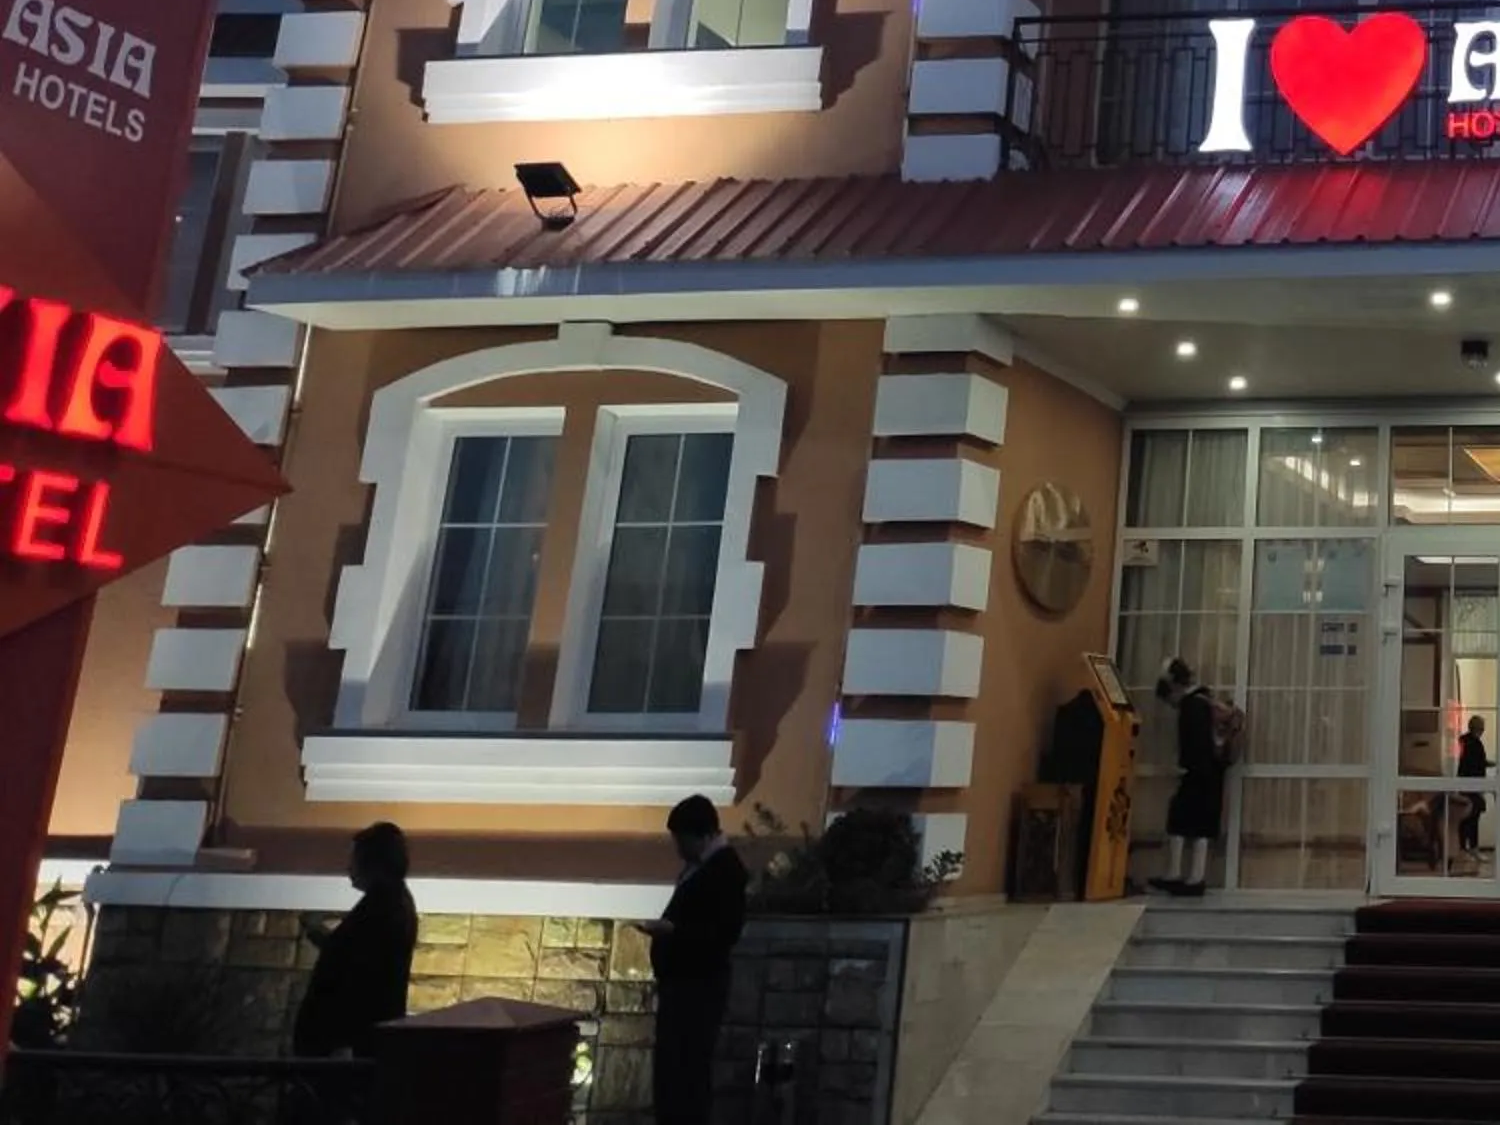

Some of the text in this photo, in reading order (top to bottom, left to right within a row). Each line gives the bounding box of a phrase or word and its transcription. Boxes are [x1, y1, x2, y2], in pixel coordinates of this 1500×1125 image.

[13, 62, 146, 142] HOTELS
[1199, 19, 1254, 152] I
[0, 286, 162, 452] IA
[0, 465, 124, 569] EL
